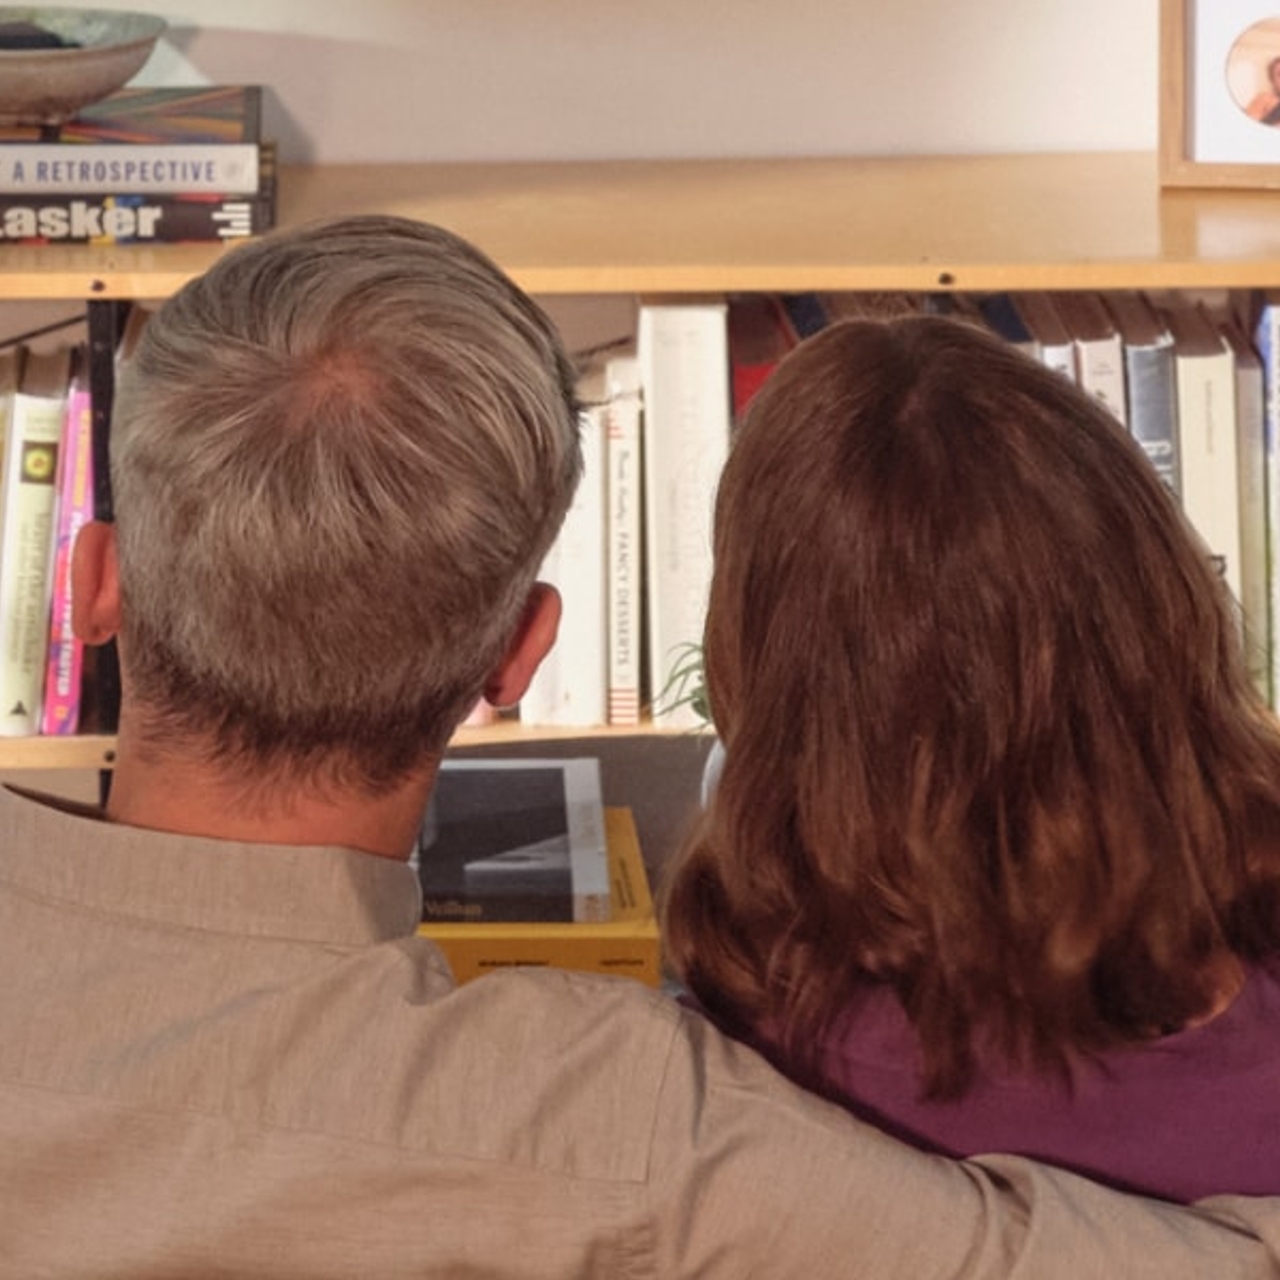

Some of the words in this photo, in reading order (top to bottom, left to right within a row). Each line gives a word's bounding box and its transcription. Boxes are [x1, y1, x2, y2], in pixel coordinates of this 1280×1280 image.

[12, 161, 25, 183] A
[36, 160, 218, 183] RETROSPECTIVE
[617, 531, 630, 581] FANCY
[617, 588, 631, 666] DESSERTS
